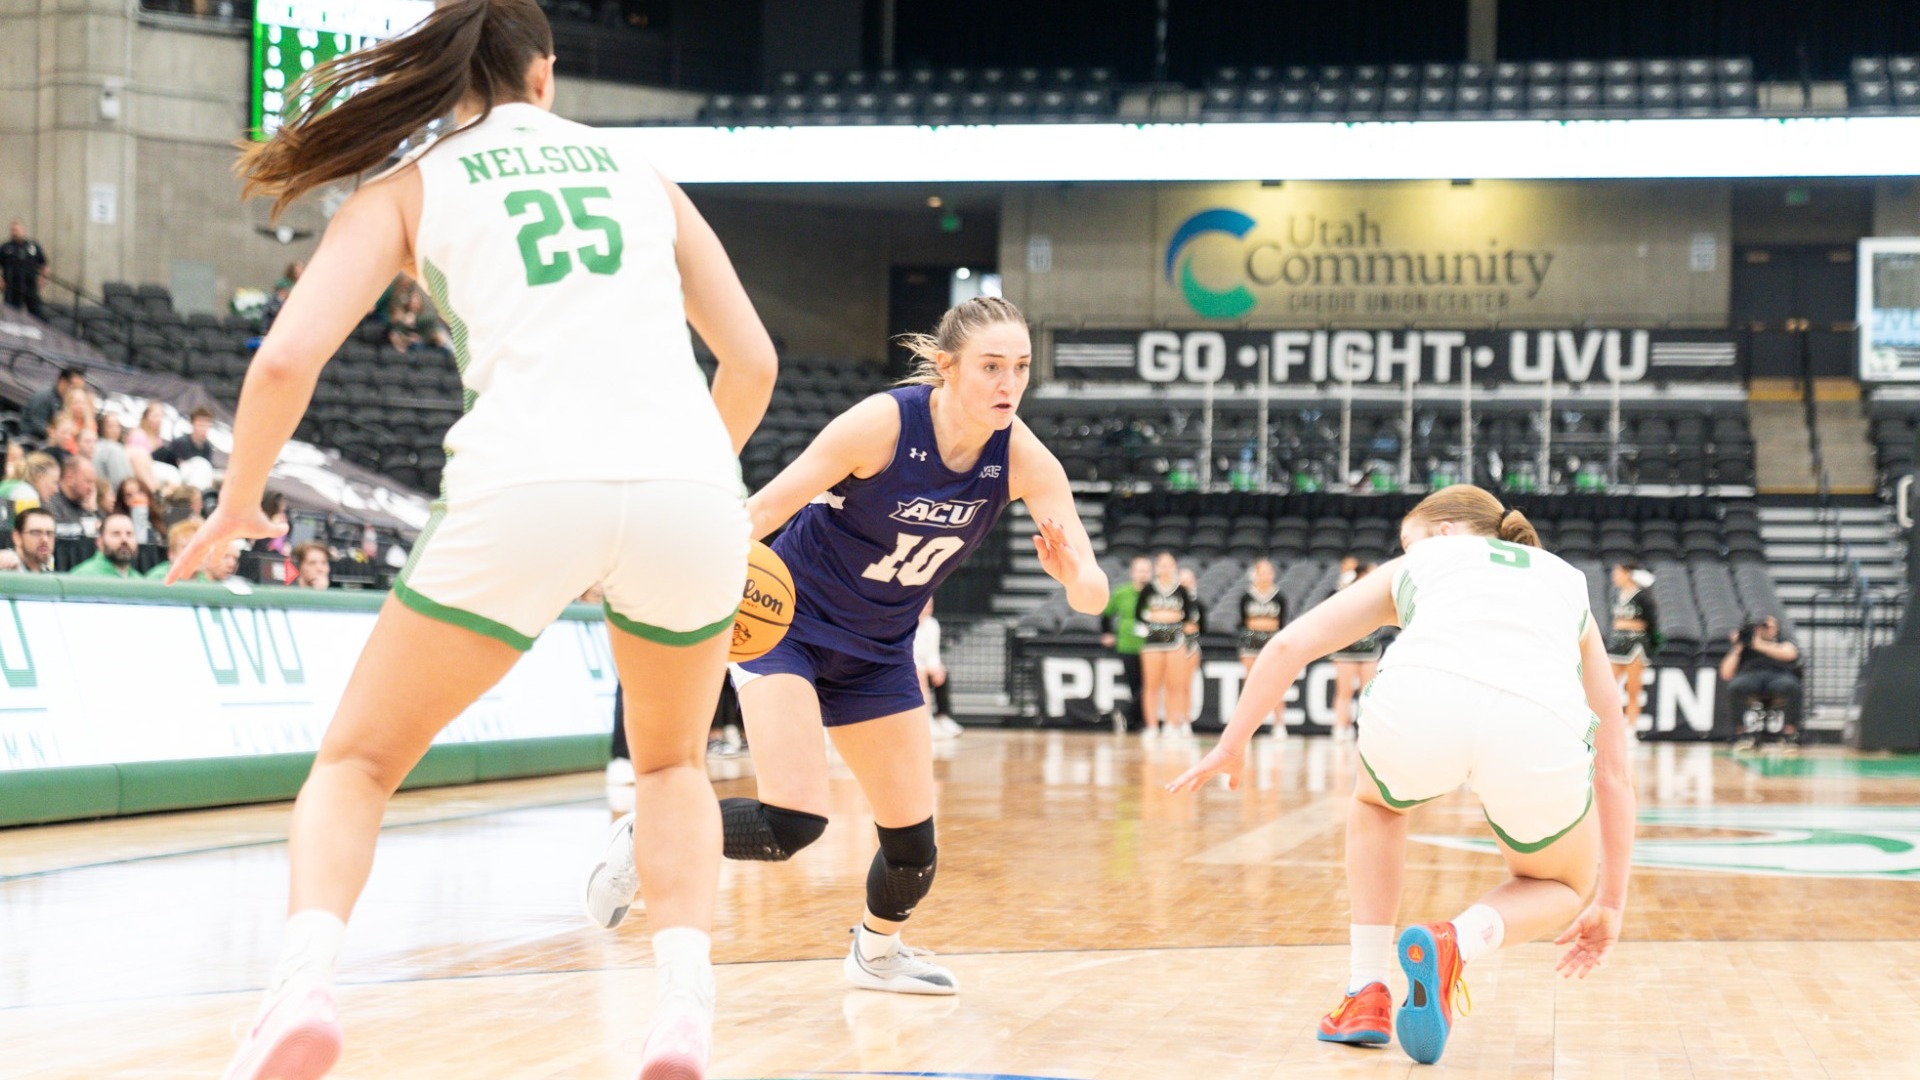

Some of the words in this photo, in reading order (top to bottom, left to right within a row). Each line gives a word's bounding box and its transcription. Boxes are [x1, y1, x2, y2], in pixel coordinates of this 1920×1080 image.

[458, 145, 619, 184] NELSON
[504, 186, 623, 287] 25
[1288, 210, 1382, 248] Utah
[1244, 238, 1555, 299] Community
[1137, 331, 1228, 383] GO
[1272, 331, 1466, 383] FIGHT
[1509, 331, 1649, 383] UVU
[897, 500, 978, 526] ACU
[861, 532, 965, 587] 10
[742, 578, 784, 616] lson
